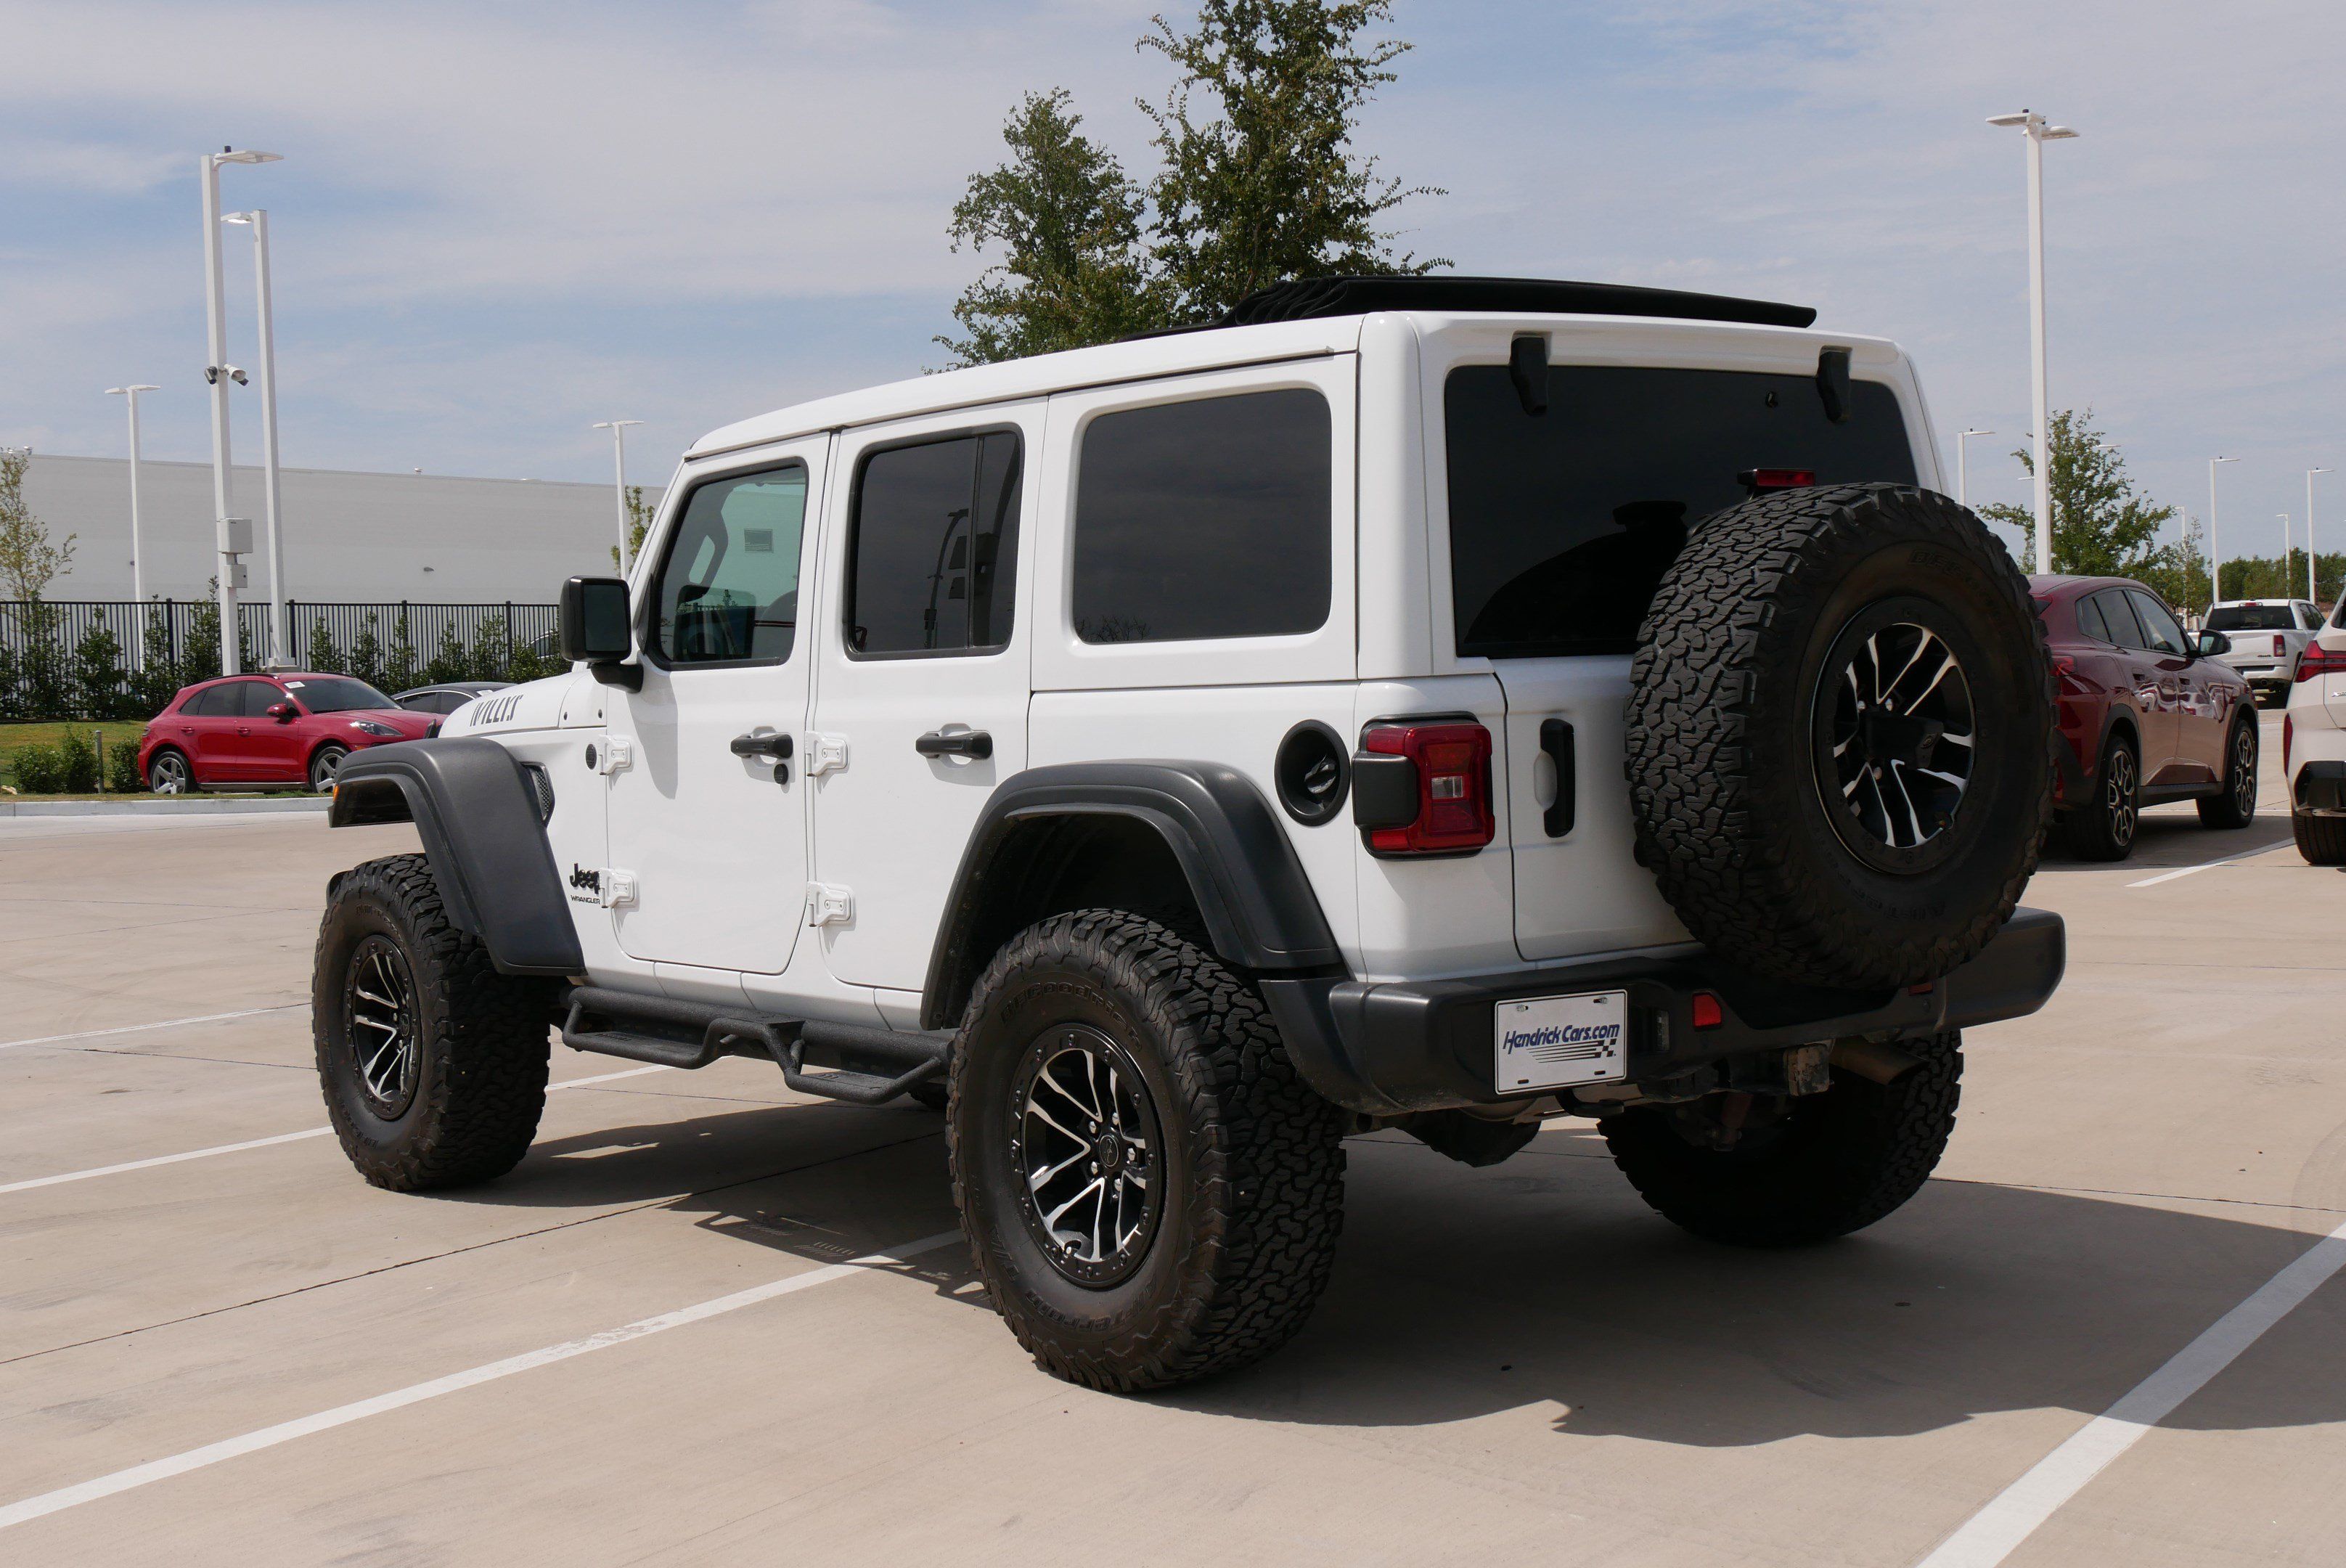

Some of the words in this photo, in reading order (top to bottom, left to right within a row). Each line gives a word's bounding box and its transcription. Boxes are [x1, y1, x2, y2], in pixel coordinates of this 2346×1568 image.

[469, 694, 524, 727] WILLYS
[569, 862, 600, 895] Jeep
[570, 894, 601, 905] WRANGLER
